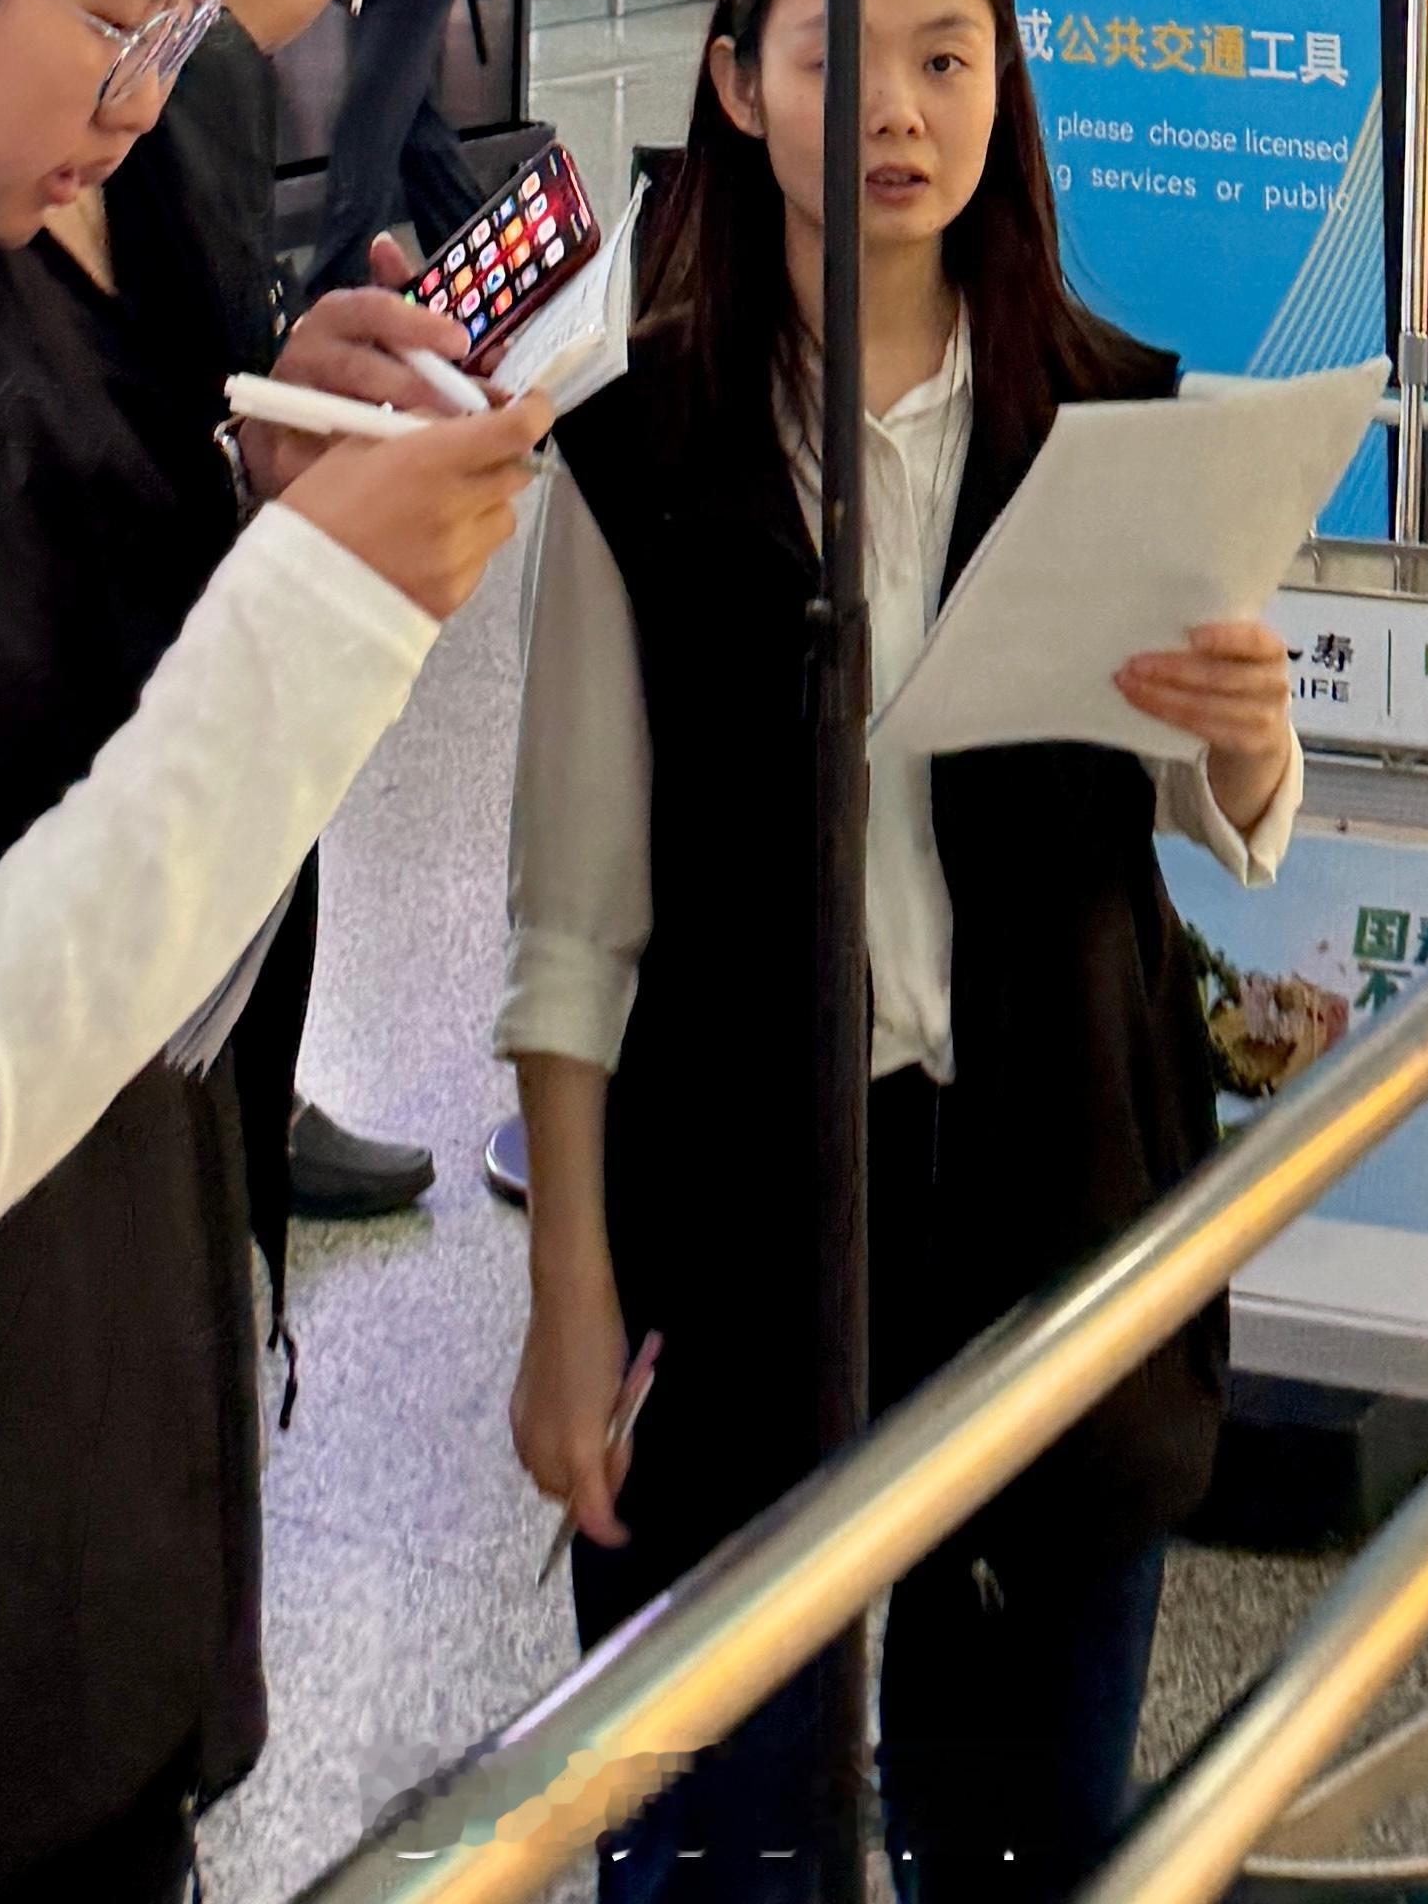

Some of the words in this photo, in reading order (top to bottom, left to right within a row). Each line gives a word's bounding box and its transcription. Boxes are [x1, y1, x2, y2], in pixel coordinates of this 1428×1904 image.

[1016, 7, 1349, 87] 或公共交通工具
[1058, 111, 1134, 141] please
[1149, 119, 1237, 152] choose
[1245, 127, 1349, 162] licensed
[1092, 165, 1196, 197] services
[1216, 178, 1244, 201] or
[1265, 183, 1351, 211] public
[1292, 677, 1350, 703] IFE
